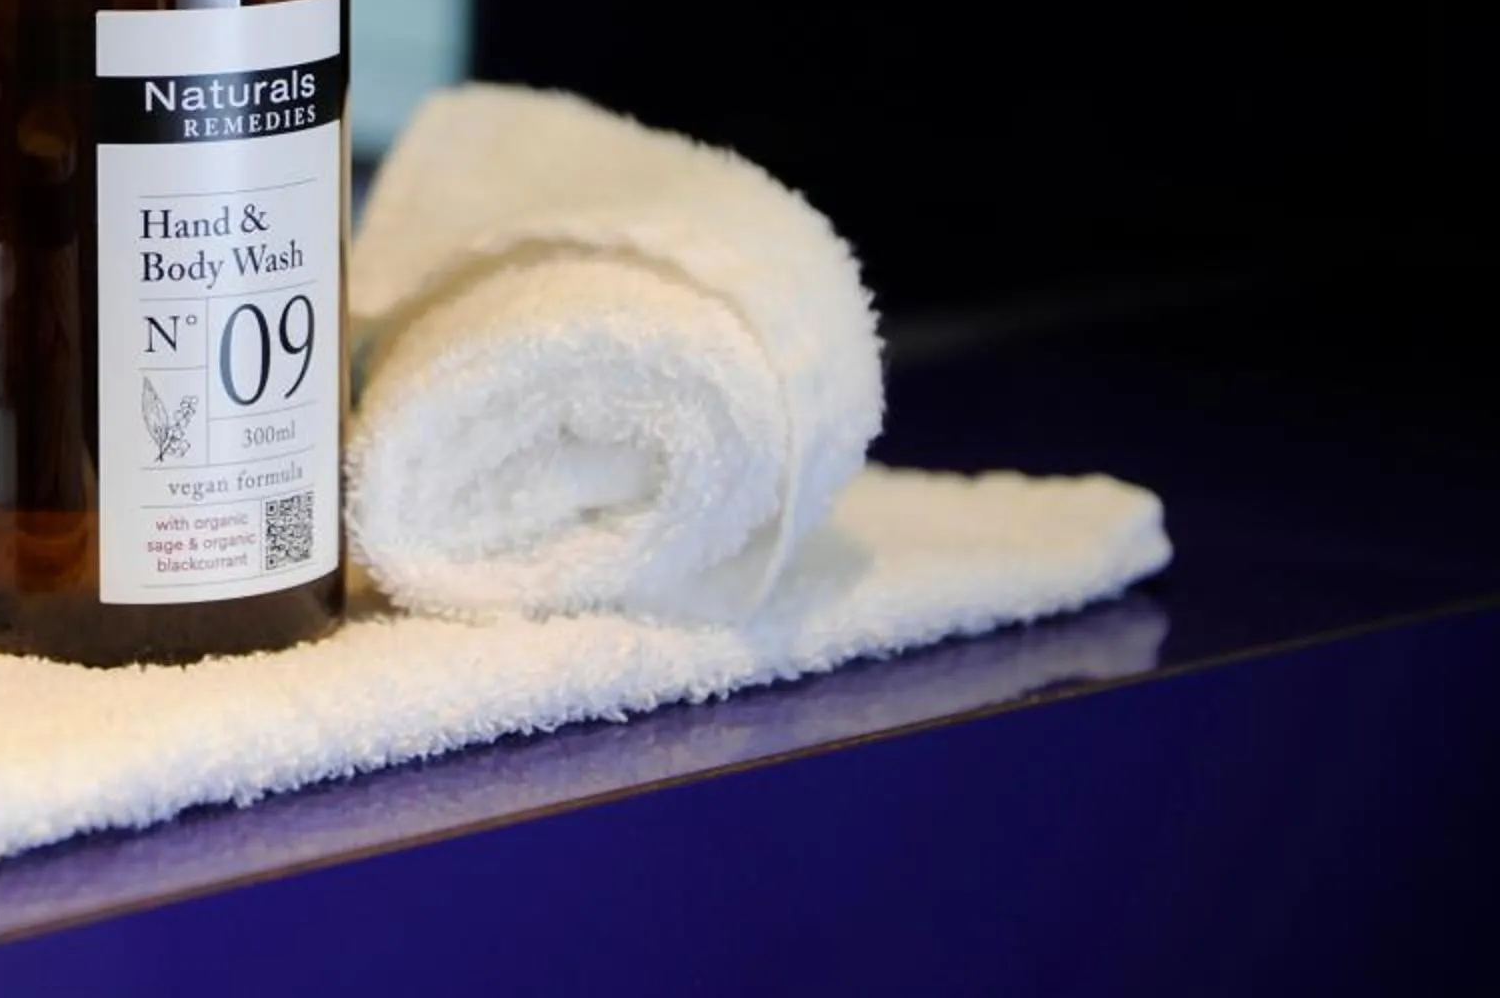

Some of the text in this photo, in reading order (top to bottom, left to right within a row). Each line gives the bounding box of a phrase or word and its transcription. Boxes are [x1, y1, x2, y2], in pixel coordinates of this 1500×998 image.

[145, 69, 316, 113] Naturals
[183, 104, 317, 138] REMEDIES
[139, 203, 270, 239] Hand &
[140, 239, 304, 290] Body Wash
[219, 294, 316, 407] 09
[242, 420, 296, 449] 300ml
[168, 459, 304, 501] vegan formula
[155, 512, 249, 531] with organic
[147, 532, 257, 555] sage & organic
[157, 552, 248, 572] blackcurrant
